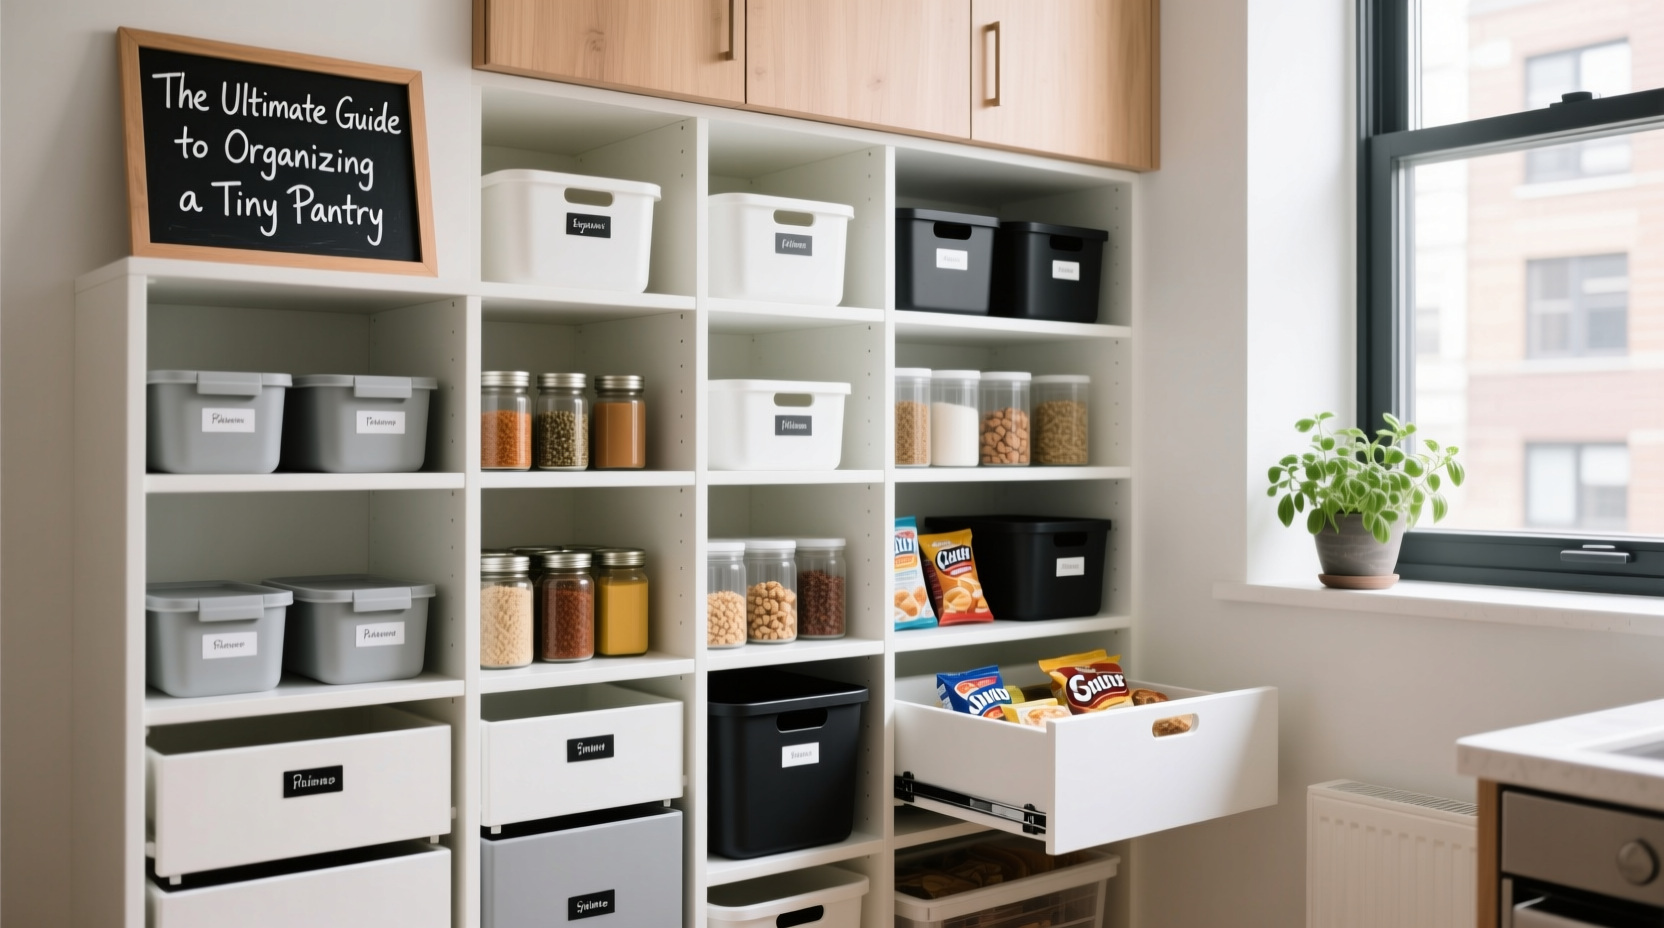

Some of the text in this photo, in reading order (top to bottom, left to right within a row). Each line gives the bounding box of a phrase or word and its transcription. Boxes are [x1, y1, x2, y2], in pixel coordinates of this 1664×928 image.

[152, 72, 402, 134] The Ultimate Guide
[174, 126, 374, 191] to Organizing
[179, 181, 383, 246] a Tiny Pantry
